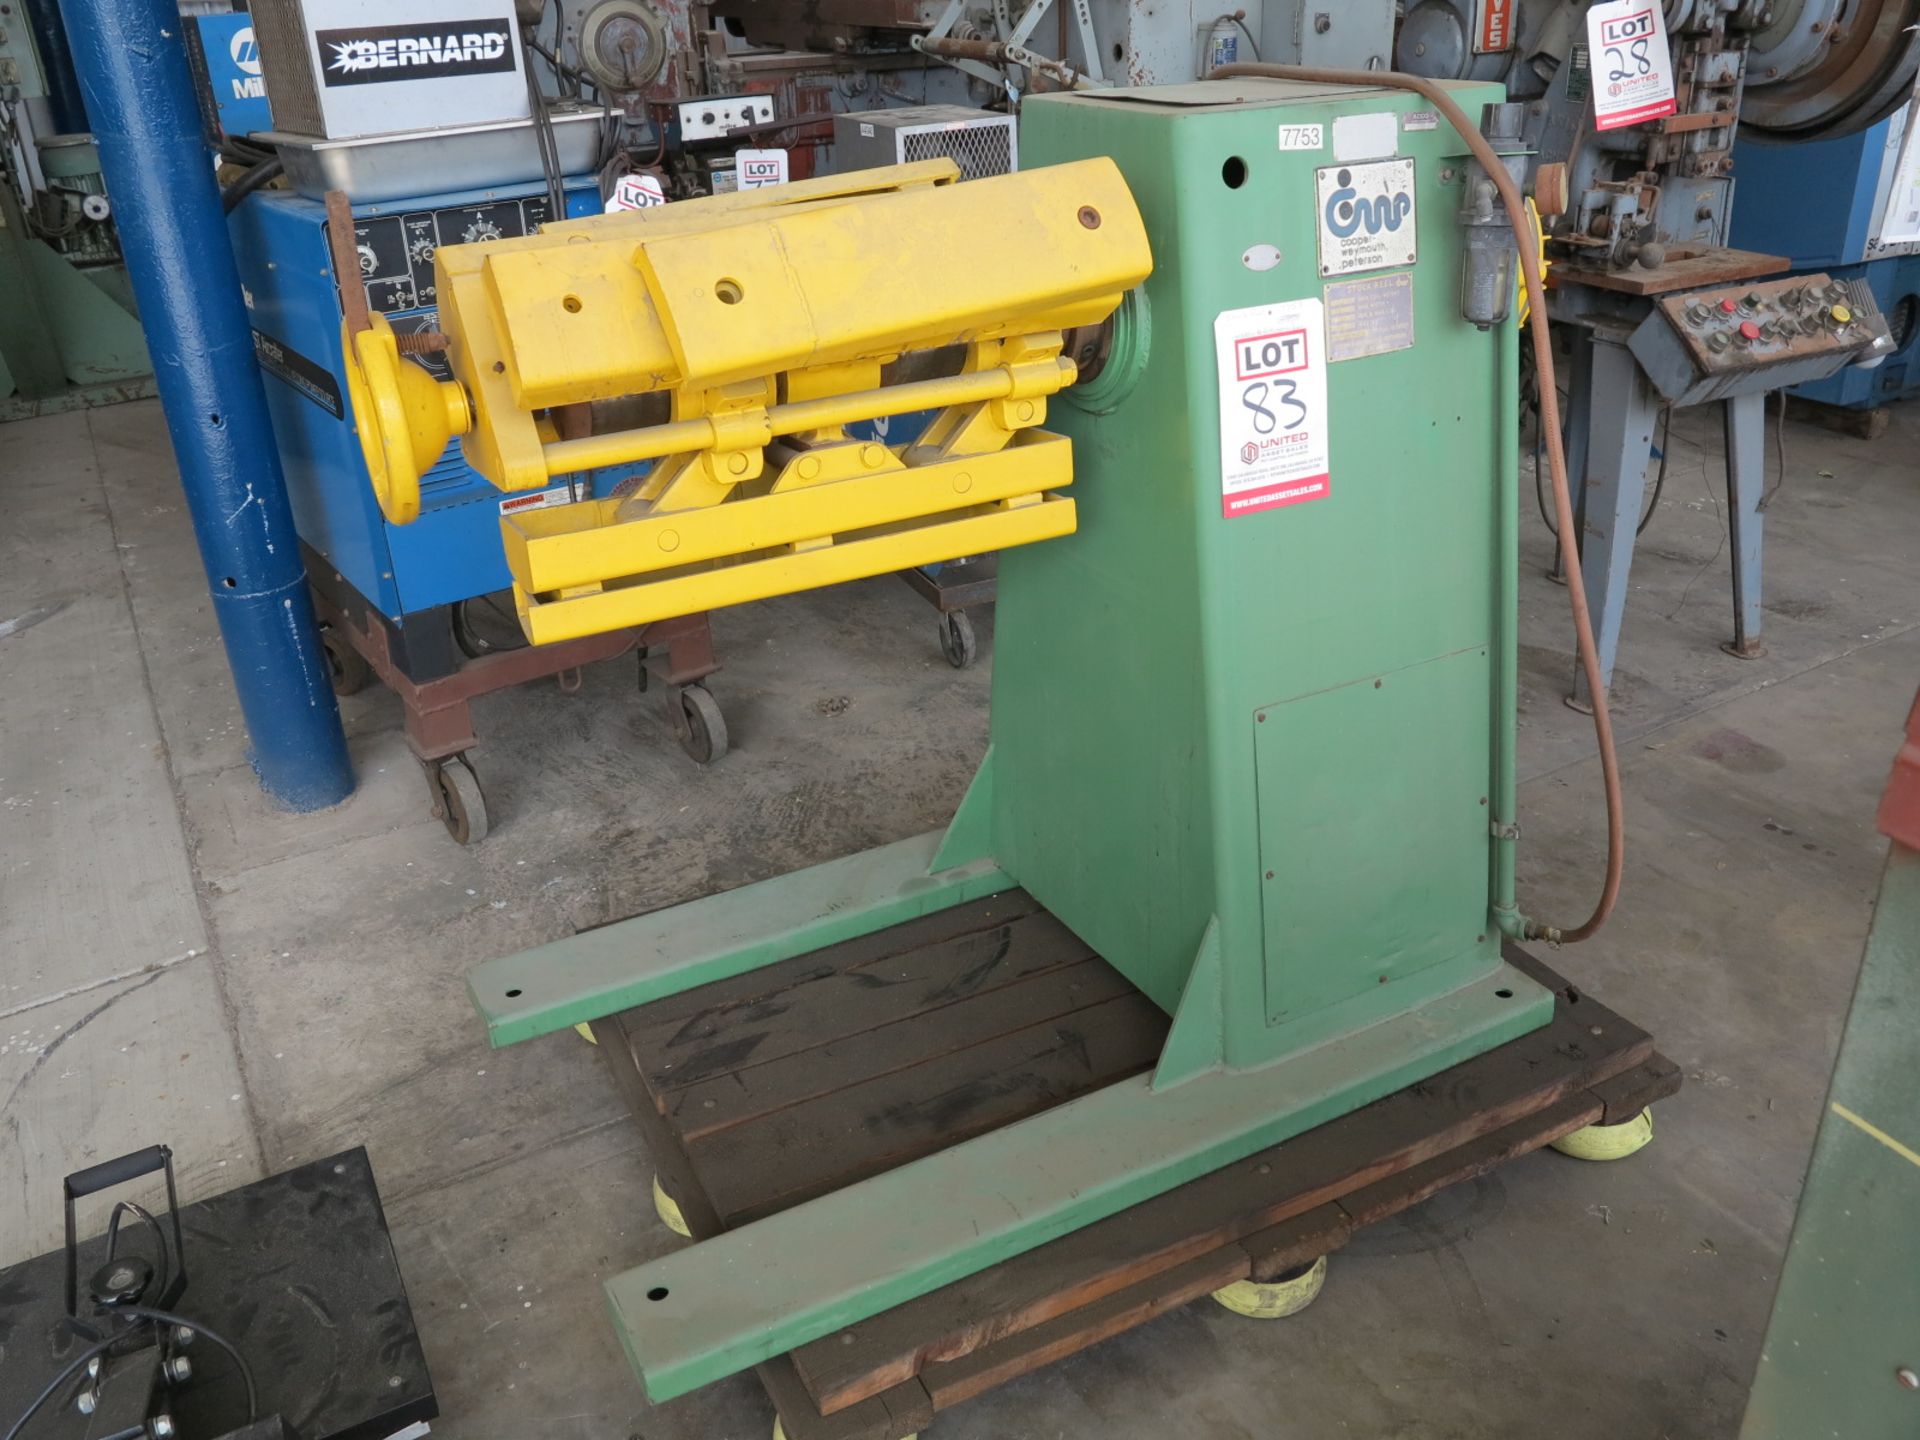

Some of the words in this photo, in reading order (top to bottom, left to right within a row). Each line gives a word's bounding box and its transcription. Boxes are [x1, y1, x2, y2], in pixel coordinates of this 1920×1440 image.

[1608, 16, 1649, 40] LOT
[358, 32, 505, 70] BERNARD
[1605, 38, 1651, 81] 28
[1622, 72, 1659, 87] UNITED
[1282, 127, 1321, 147] 7753
[749, 164, 776, 175] LOT
[624, 187, 661, 208] LOT
[1244, 338, 1300, 371] LOT
[1242, 378, 1307, 434] 83
[1260, 431, 1309, 449] UNITED
